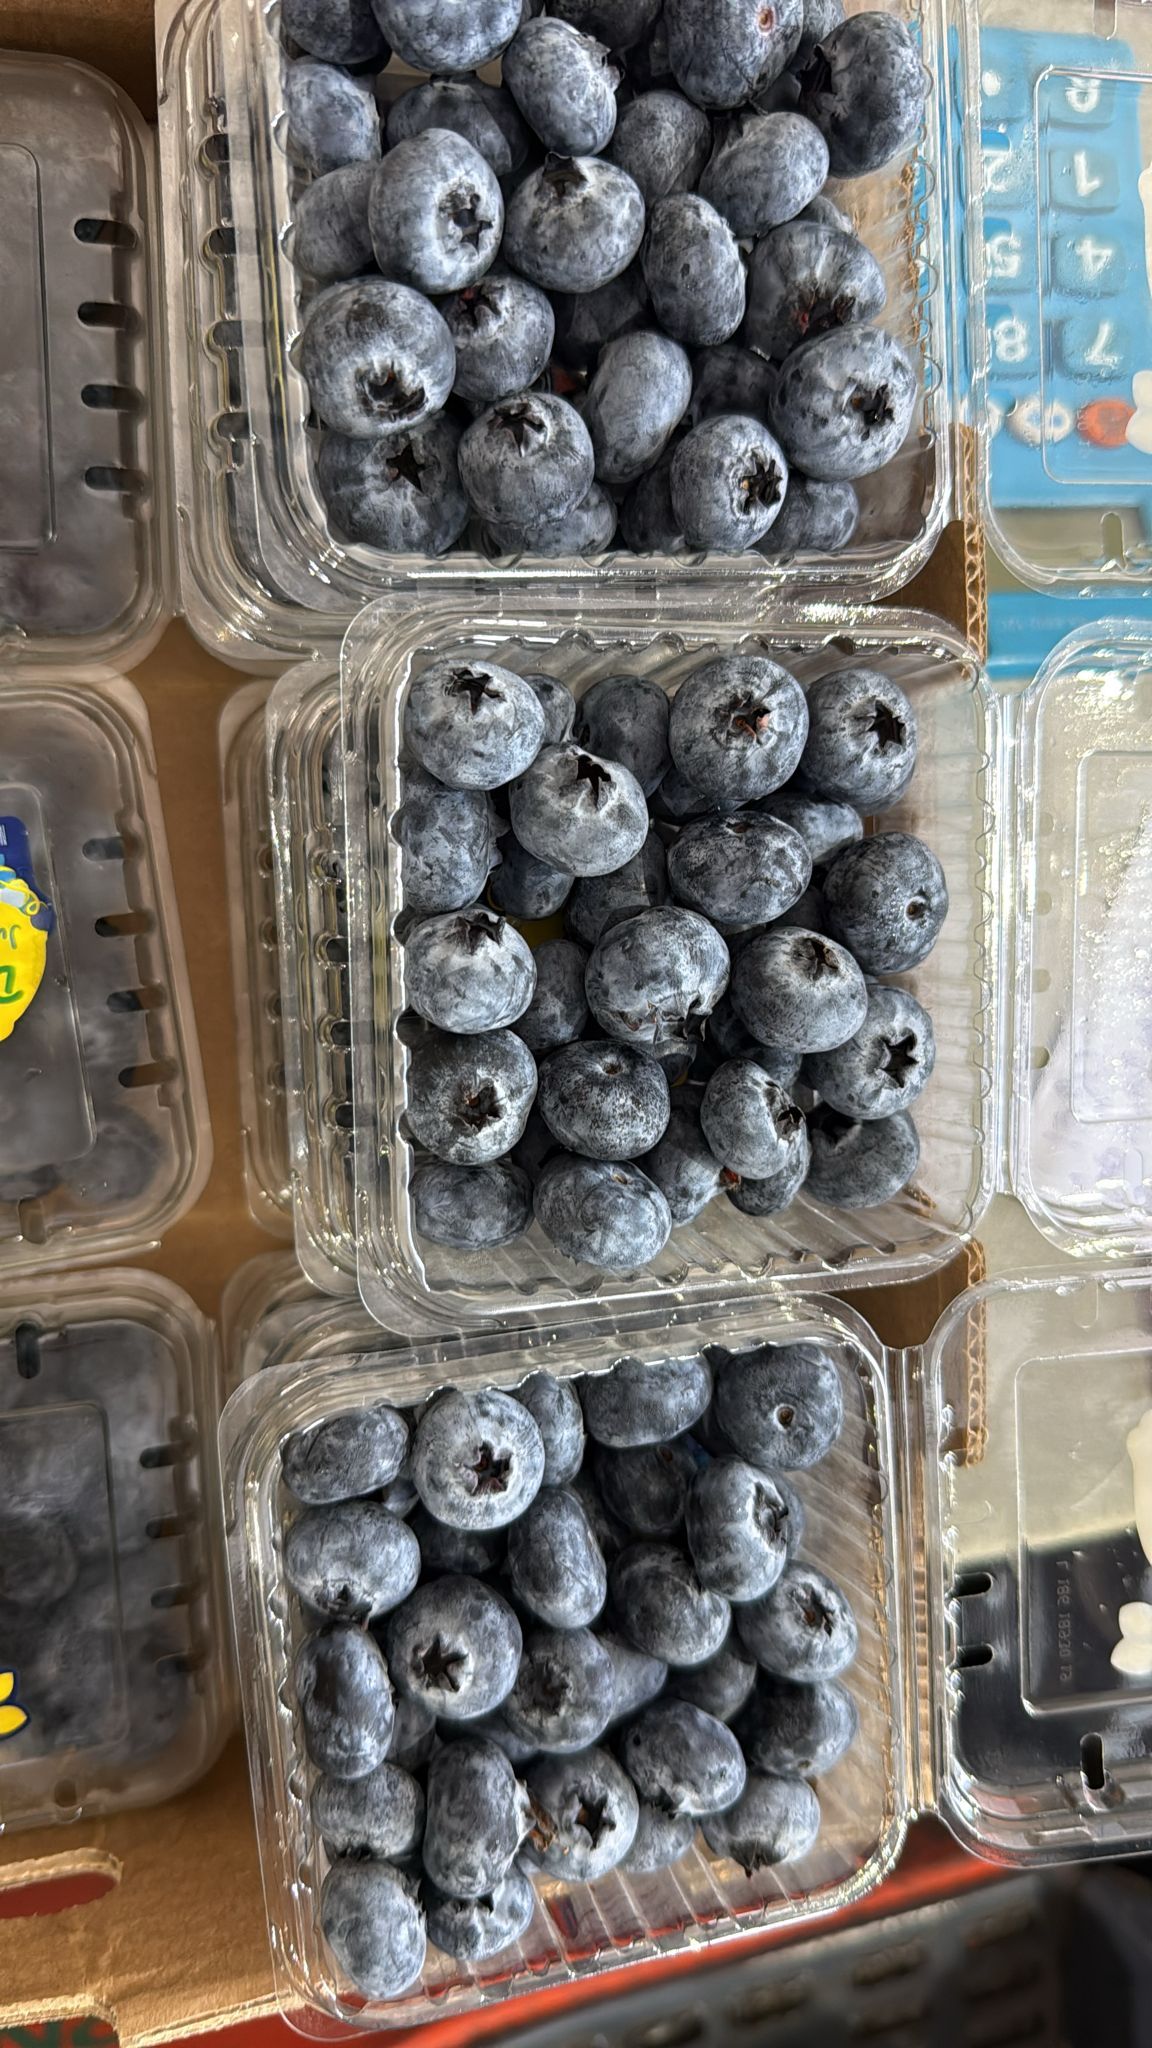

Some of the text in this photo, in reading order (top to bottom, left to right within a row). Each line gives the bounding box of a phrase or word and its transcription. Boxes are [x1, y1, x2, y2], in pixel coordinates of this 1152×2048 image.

[990, 235, 1115, 281] 4 5
[993, 318, 1123, 366] 7 8
